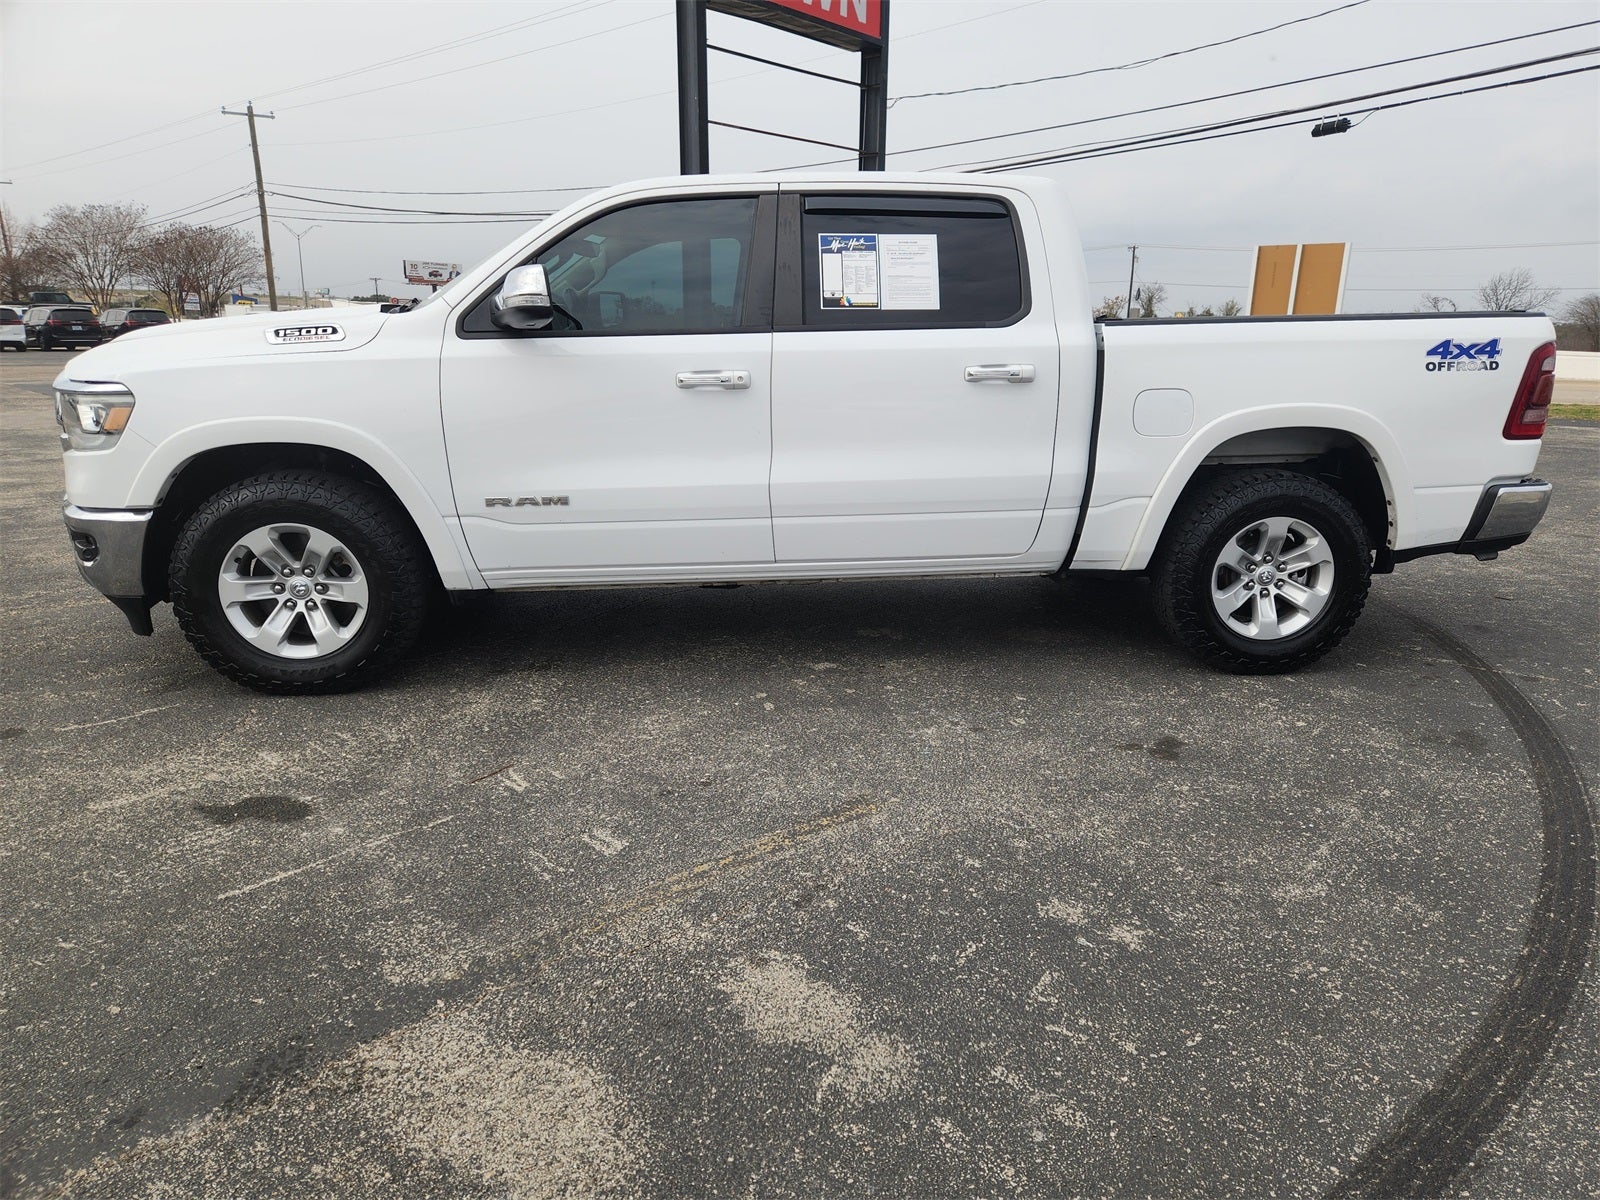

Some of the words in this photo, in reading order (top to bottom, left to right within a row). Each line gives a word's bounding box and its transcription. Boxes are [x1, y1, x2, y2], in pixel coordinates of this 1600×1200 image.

[802, 0, 867, 24] N
[277, 326, 333, 338] 1500
[1425, 360, 1500, 372] OFFROAD
[485, 496, 570, 507] RAM
